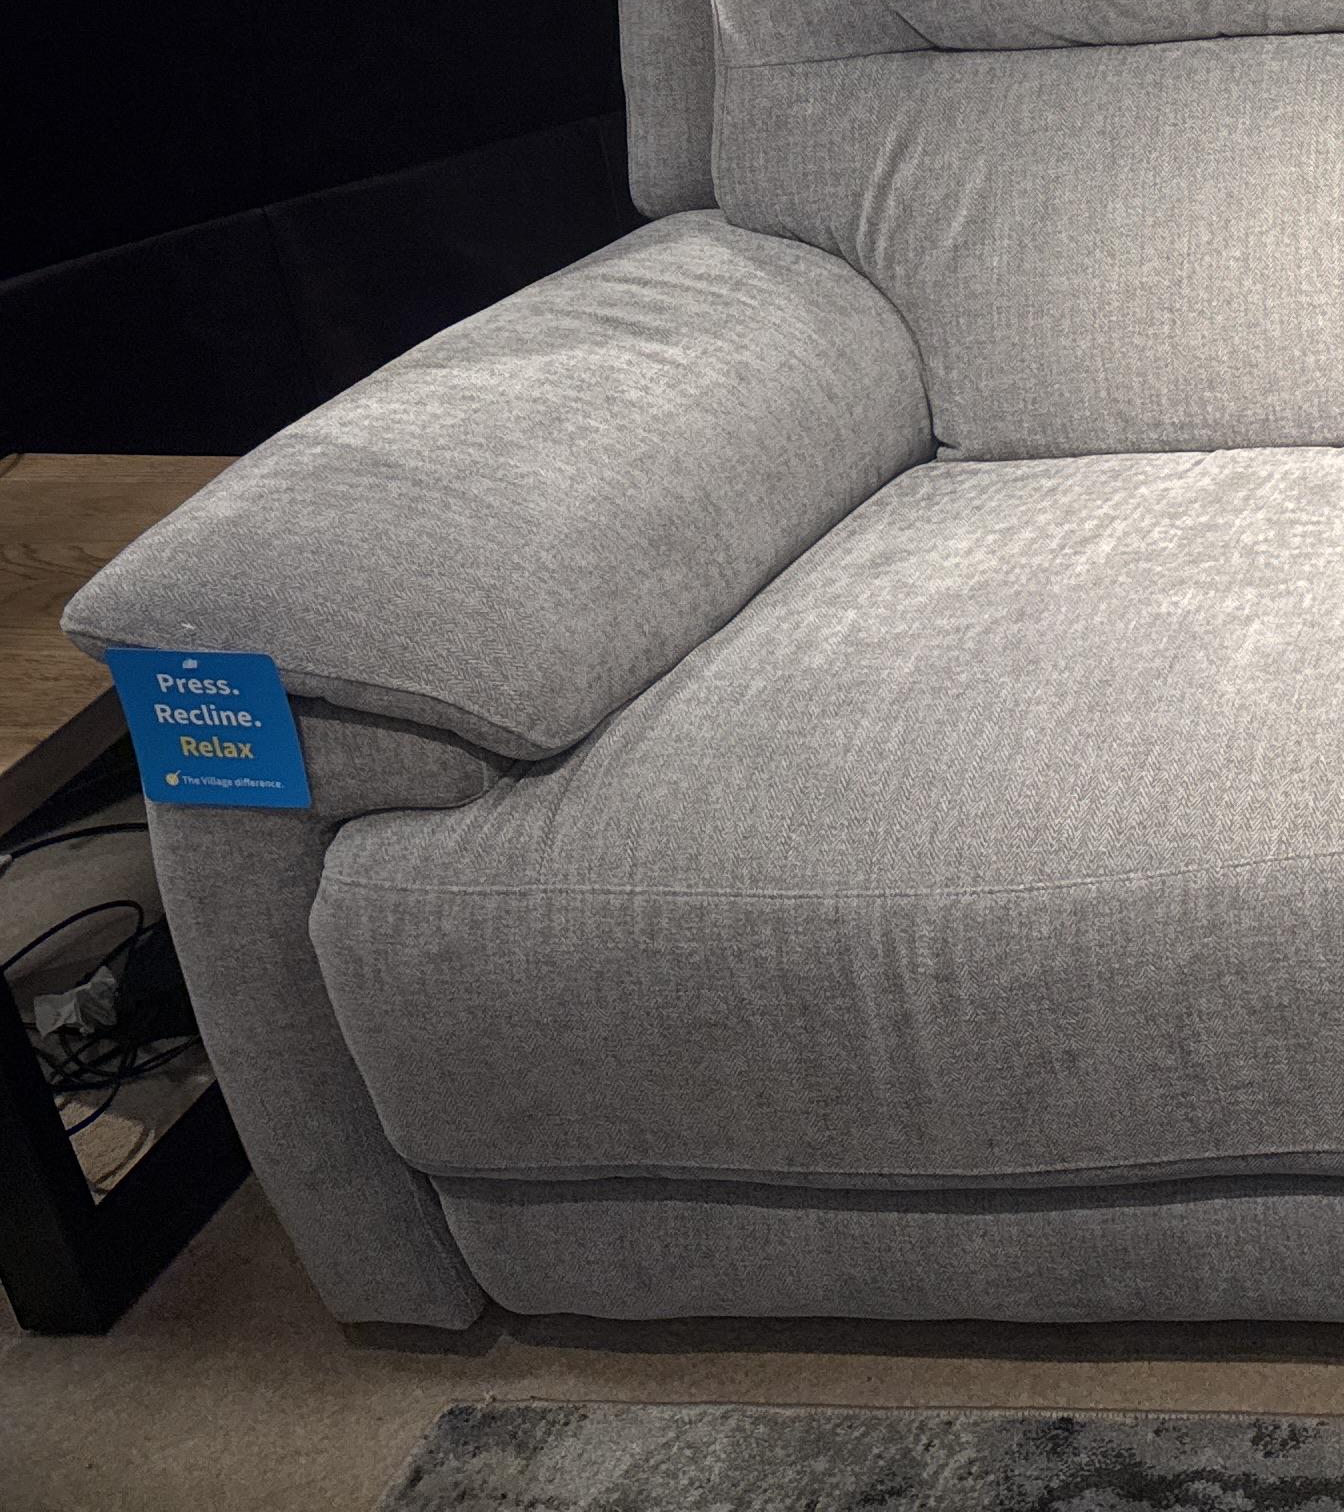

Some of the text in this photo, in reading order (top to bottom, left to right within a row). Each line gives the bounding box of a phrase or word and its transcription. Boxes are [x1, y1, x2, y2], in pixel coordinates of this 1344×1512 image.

[156, 673, 240, 696] Press.
[154, 703, 262, 728] Recline.
[179, 736, 254, 759] Relax
[182, 775, 285, 789] The Village difference.
